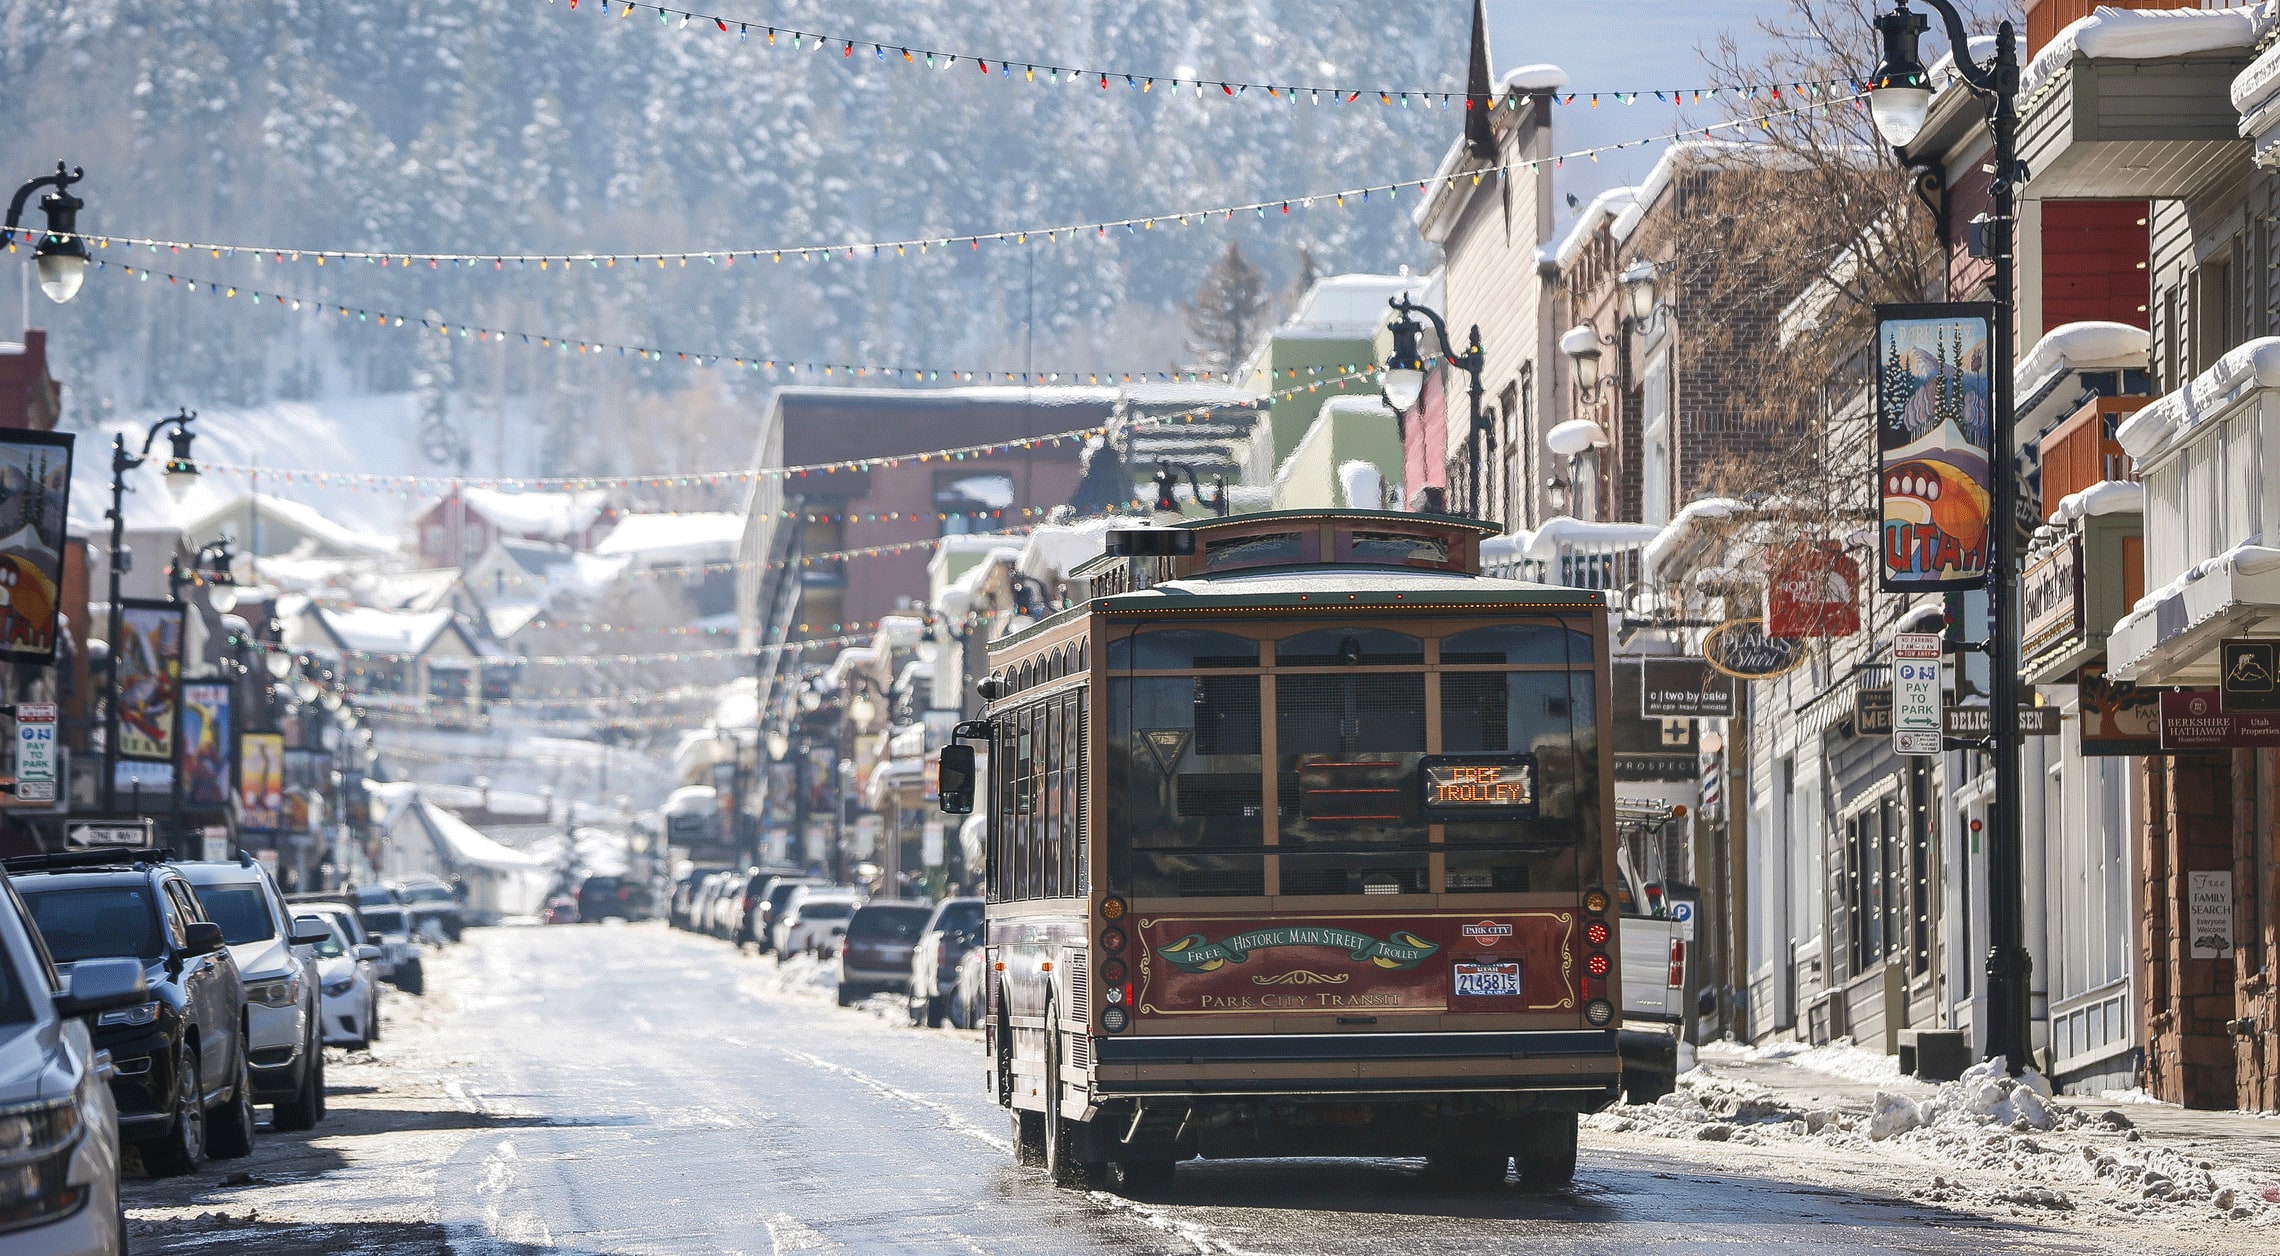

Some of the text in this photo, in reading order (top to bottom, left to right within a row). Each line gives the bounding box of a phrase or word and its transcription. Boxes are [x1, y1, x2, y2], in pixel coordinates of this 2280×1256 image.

[1899, 325, 1972, 343] PARK CITY
[1886, 524, 1988, 573] UTAH
[1906, 683, 1929, 692] PAY
[1666, 690, 1684, 700] two
[1686, 690, 1700, 703] by
[1703, 690, 1728, 700] cake
[1910, 694, 1926, 703] TO
[1902, 705, 1934, 714] PARK
[2136, 704, 2160, 720] FAM
[1951, 711, 2043, 730] DELICSEN
[2168, 718, 2230, 727] BERKSHIRE
[2251, 718, 2270, 726] Utah
[2170, 727, 2228, 736] HATHAWAY
[2241, 727, 2280, 737] Properties
[26, 742, 46, 750] PAY
[30, 751, 43, 759] TO
[23, 760, 49, 768] PARK
[1615, 762, 1697, 770] PROSPECT
[1453, 767, 1501, 783] FREE
[1436, 784, 1520, 801] TROLLEY
[2193, 874, 2226, 888] Free
[2194, 893, 2226, 902] FAMILY
[2192, 905, 2231, 915] SEARCH
[1466, 926, 1510, 934] PARK CITY
[1188, 929, 1418, 962] FREE HISTORIC MAIN STREET TROLLEY
[1460, 974, 1507, 990] 214581
[1201, 993, 1402, 1008] PARK CITY TRANSIT
